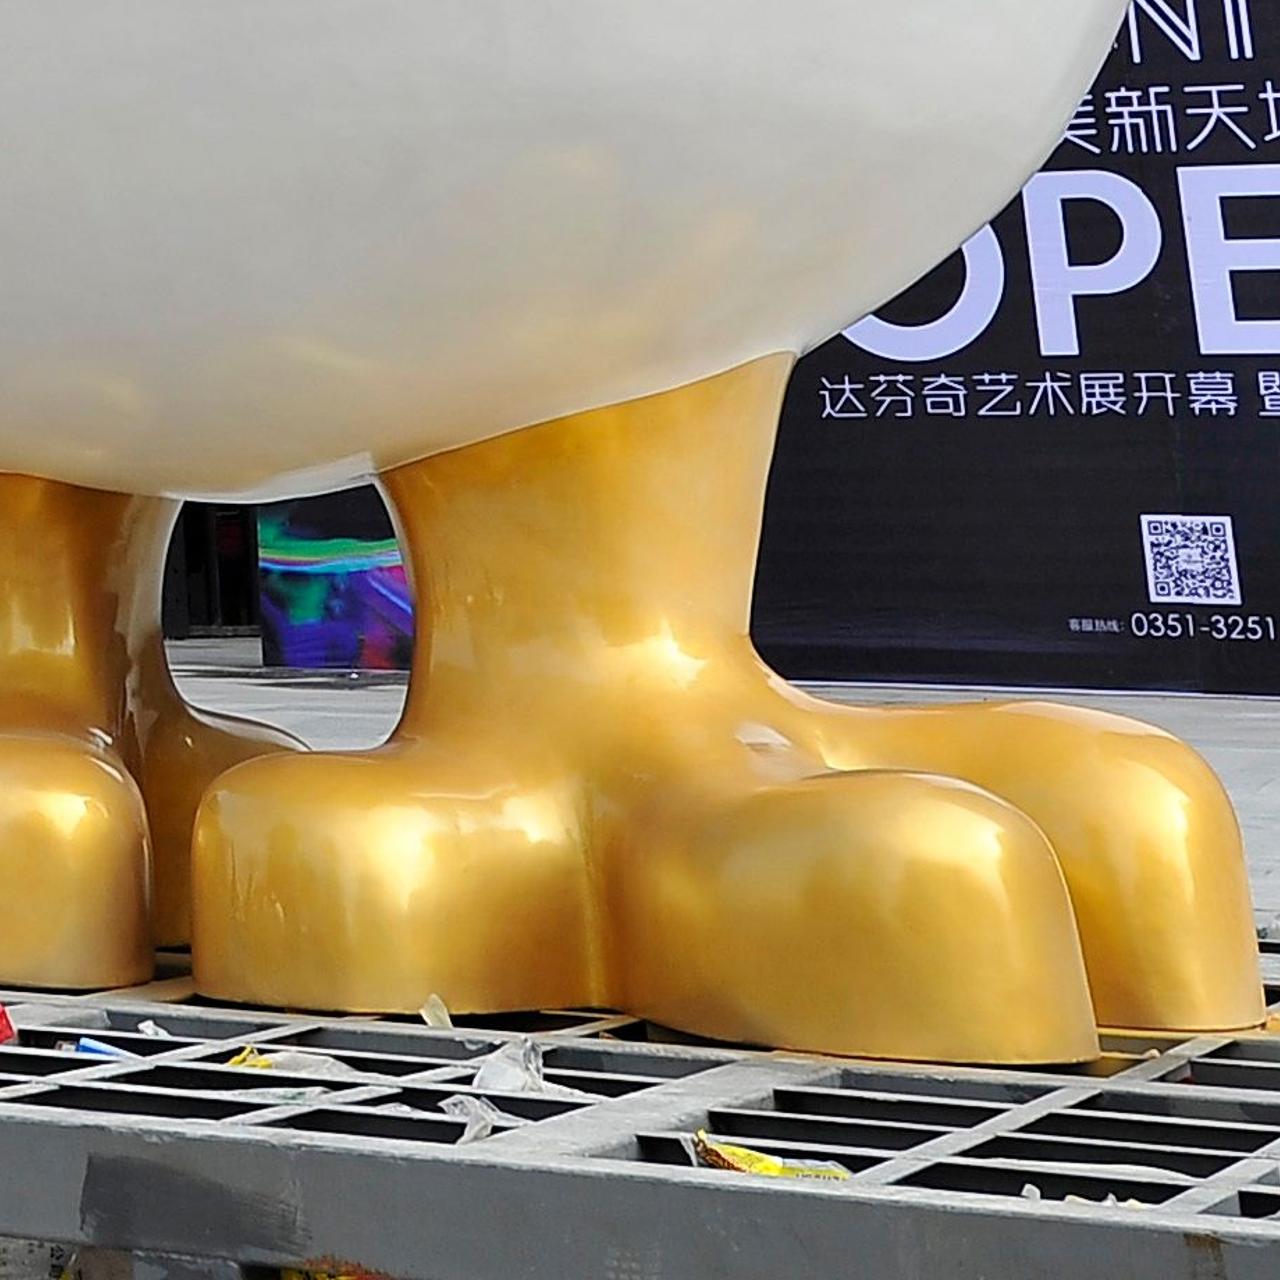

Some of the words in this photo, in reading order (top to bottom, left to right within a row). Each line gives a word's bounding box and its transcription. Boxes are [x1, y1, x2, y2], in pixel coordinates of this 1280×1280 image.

[818, 370, 1238, 418] 达芬奇艺术展开幕
[1130, 612, 1275, 640] 0351-3251
